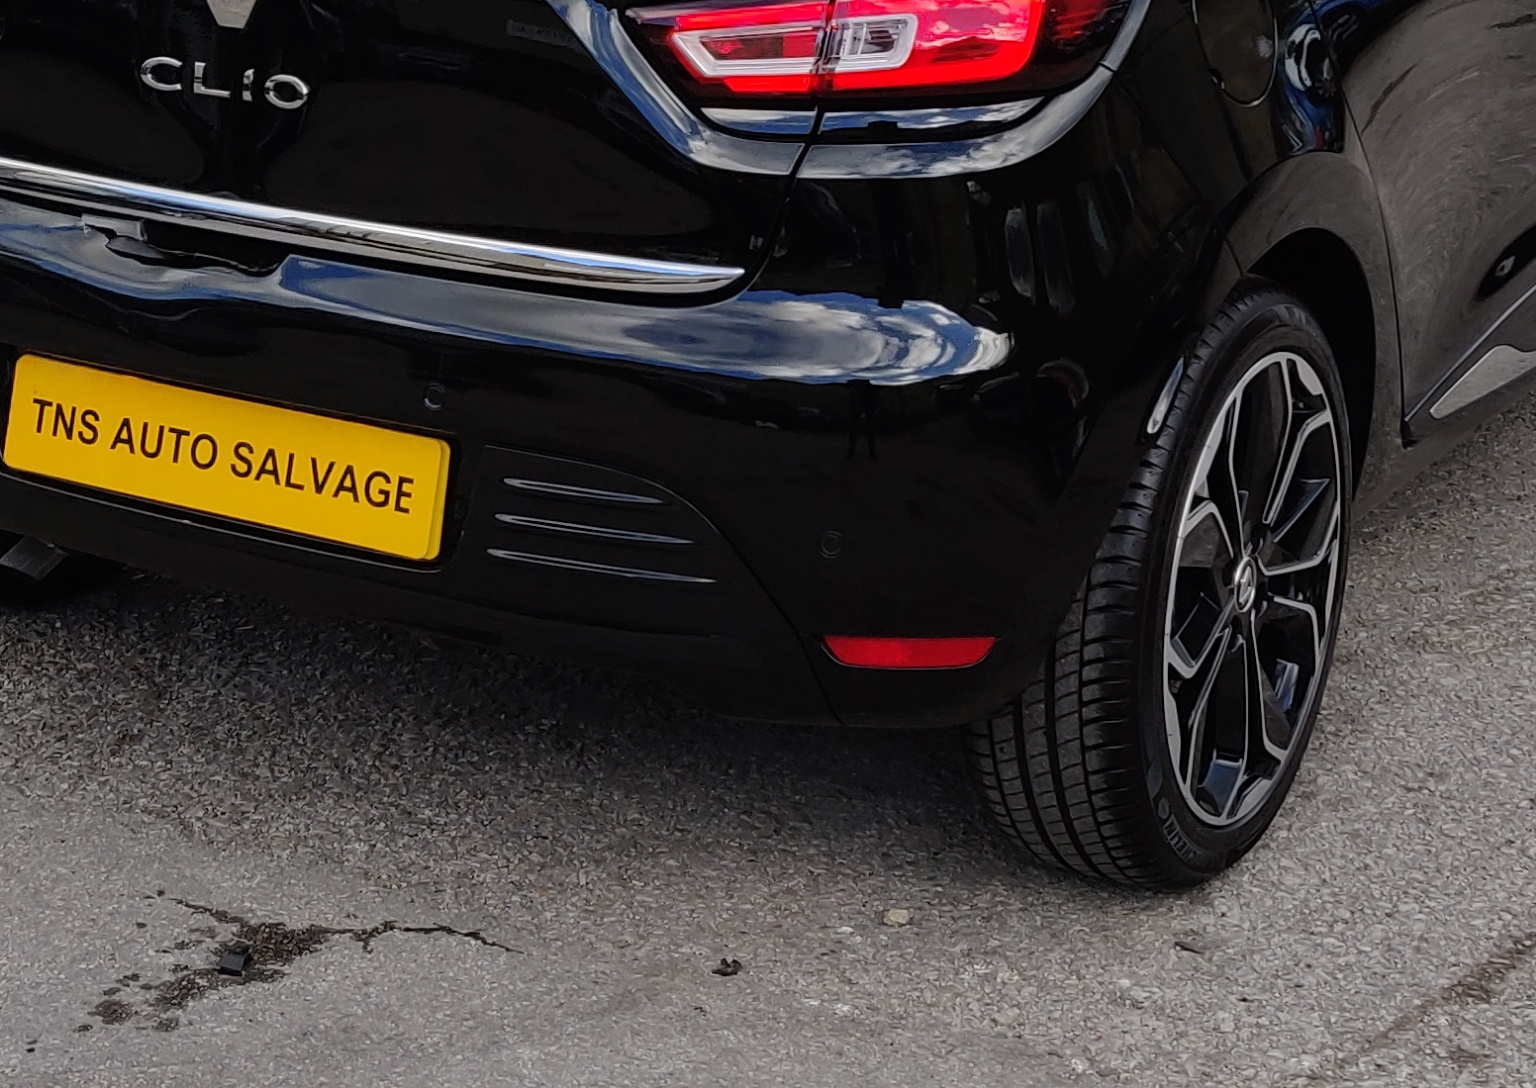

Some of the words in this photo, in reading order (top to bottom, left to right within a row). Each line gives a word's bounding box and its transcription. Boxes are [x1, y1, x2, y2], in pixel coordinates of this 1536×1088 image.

[140, 56, 311, 110] CLIO
[32, 397, 100, 445] TNS
[109, 417, 219, 470] AUTO
[230, 441, 415, 515] SALVAGE
